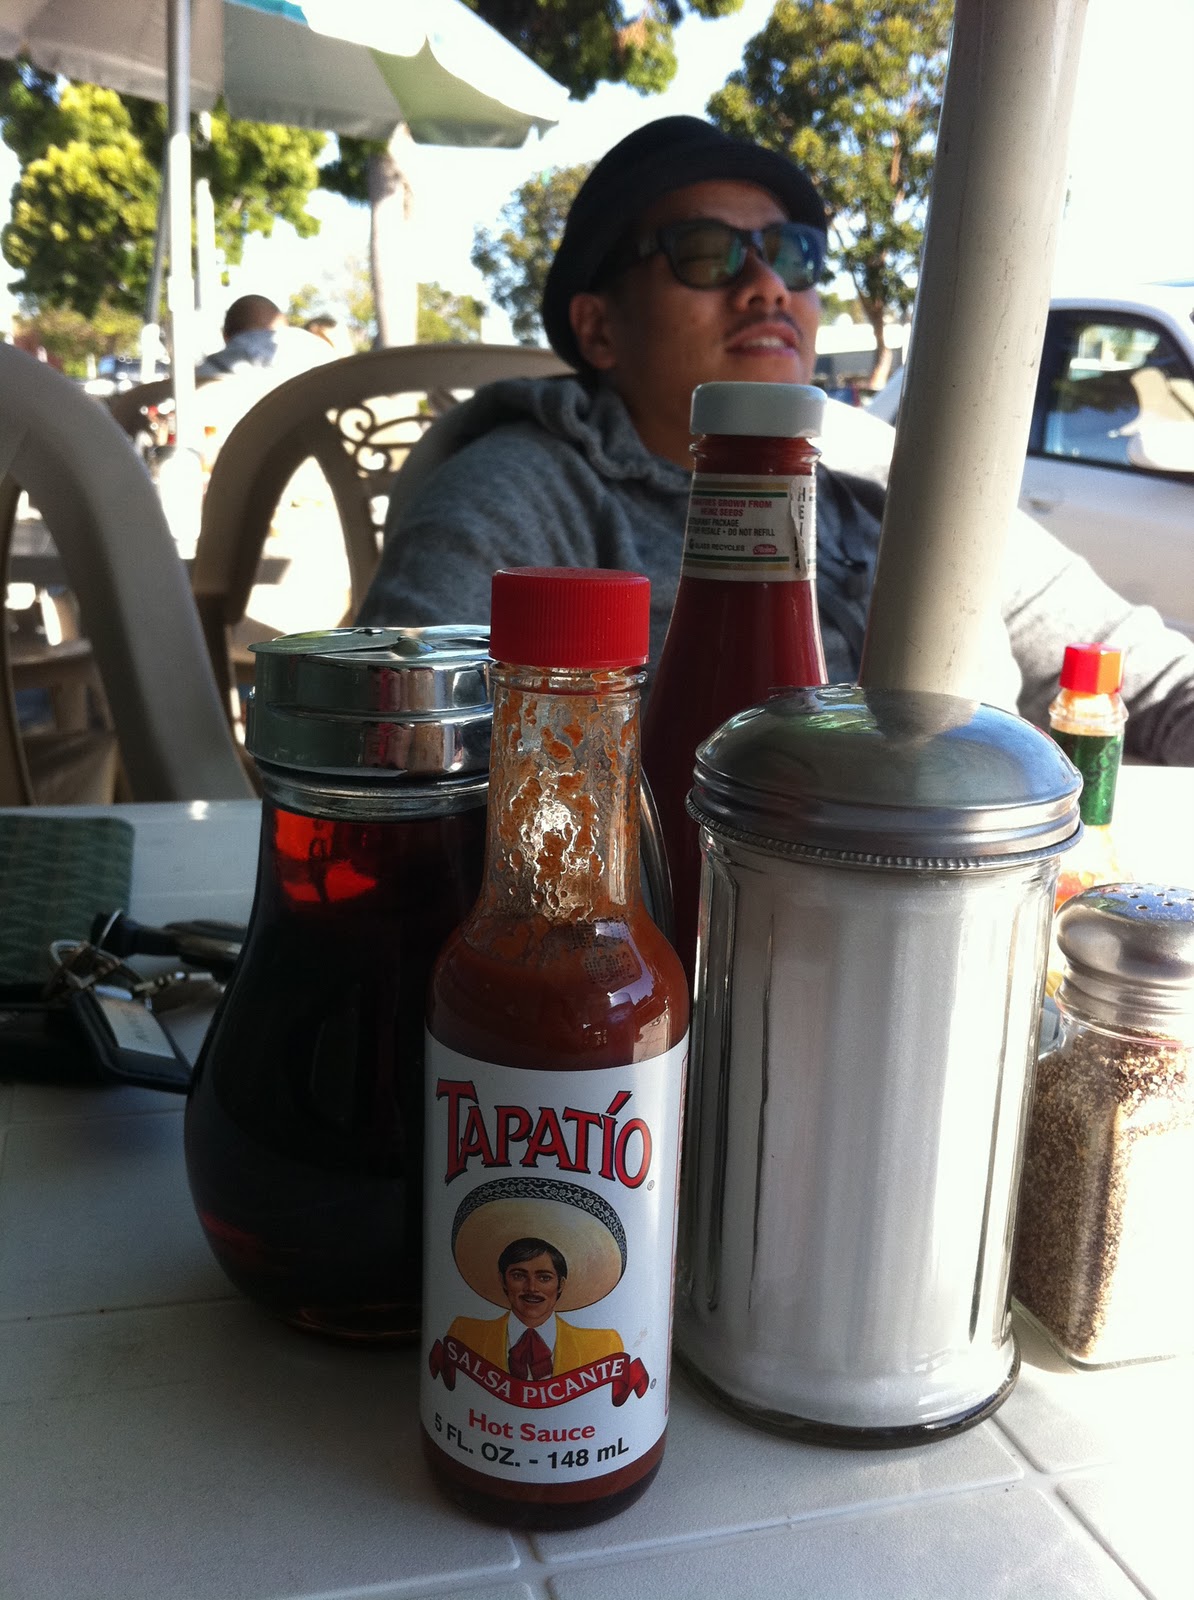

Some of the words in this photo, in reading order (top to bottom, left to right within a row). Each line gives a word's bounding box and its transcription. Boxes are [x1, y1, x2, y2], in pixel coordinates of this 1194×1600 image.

[718, 499, 747, 509] GROWN
[748, 500, 772, 509] FROM
[719, 508, 744, 517] SEEDS
[712, 518, 740, 528] PACKAGE
[728, 528, 738, 537] DO
[739, 528, 751, 537] NOT
[754, 528, 776, 537] REFILL
[711, 543, 745, 552] RECYCLES
[446, 1341, 512, 1399] SALSA
[522, 1357, 625, 1404] PICANTE
[468, 1408, 513, 1440] Hot
[520, 1422, 596, 1443] Sauce
[434, 1412, 443, 1433] 5
[446, 1421, 474, 1454] FL.
[480, 1442, 521, 1467] OZ.
[547, 1448, 590, 1469] 148
[597, 1437, 630, 1463] mL
